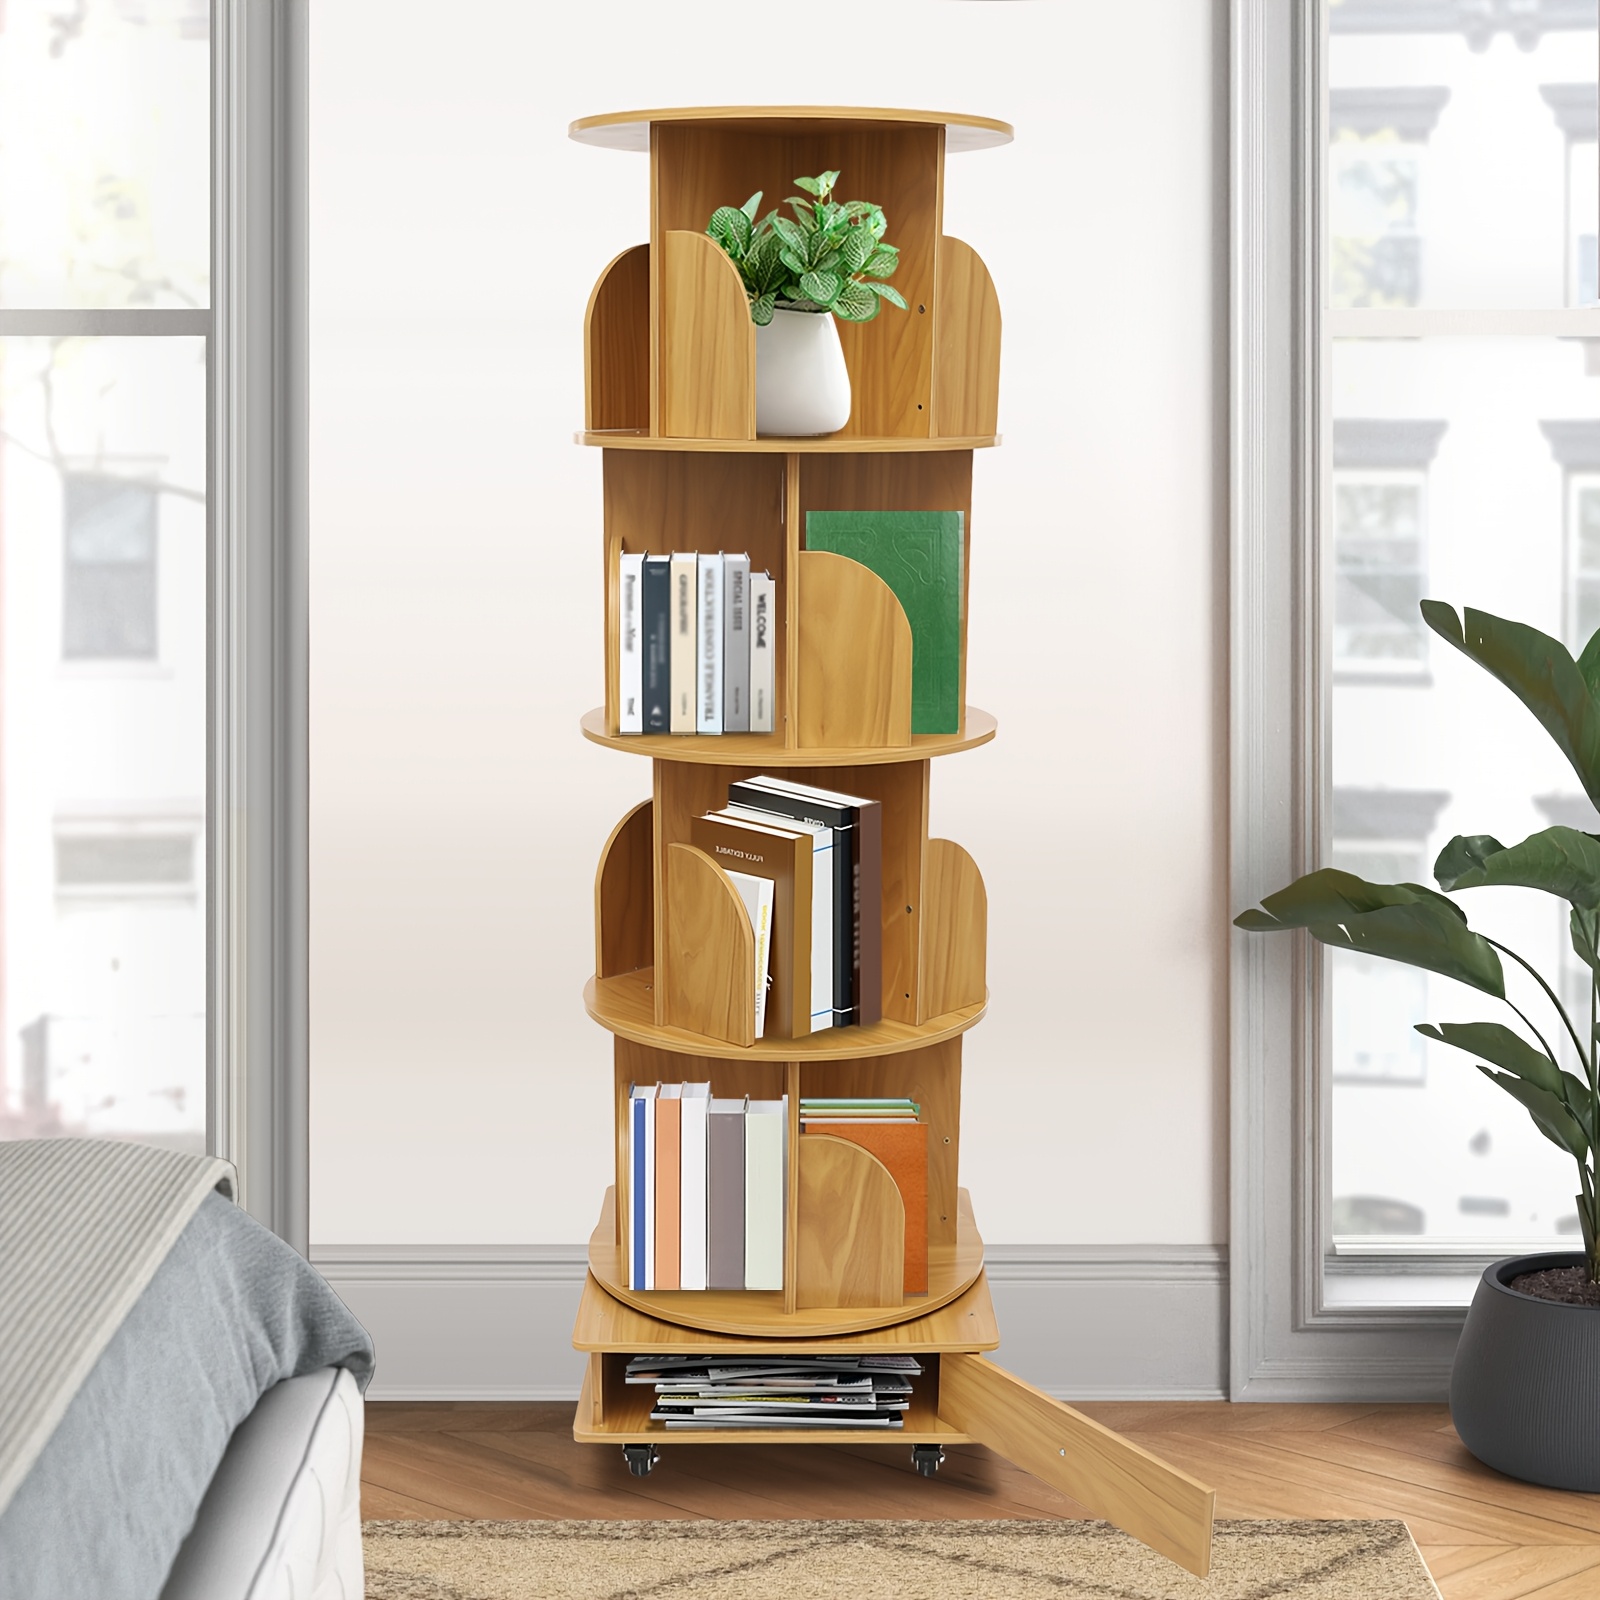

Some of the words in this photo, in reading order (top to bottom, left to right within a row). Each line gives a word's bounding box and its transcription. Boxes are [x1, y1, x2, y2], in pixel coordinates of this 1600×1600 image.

[704, 568, 715, 660] CONSTRUCTION
[733, 570, 743, 604] SPECIAL
[733, 607, 743, 631] ISSUE
[756, 593, 767, 648] WELCOME
[704, 663, 715, 722] TRIANGLE
